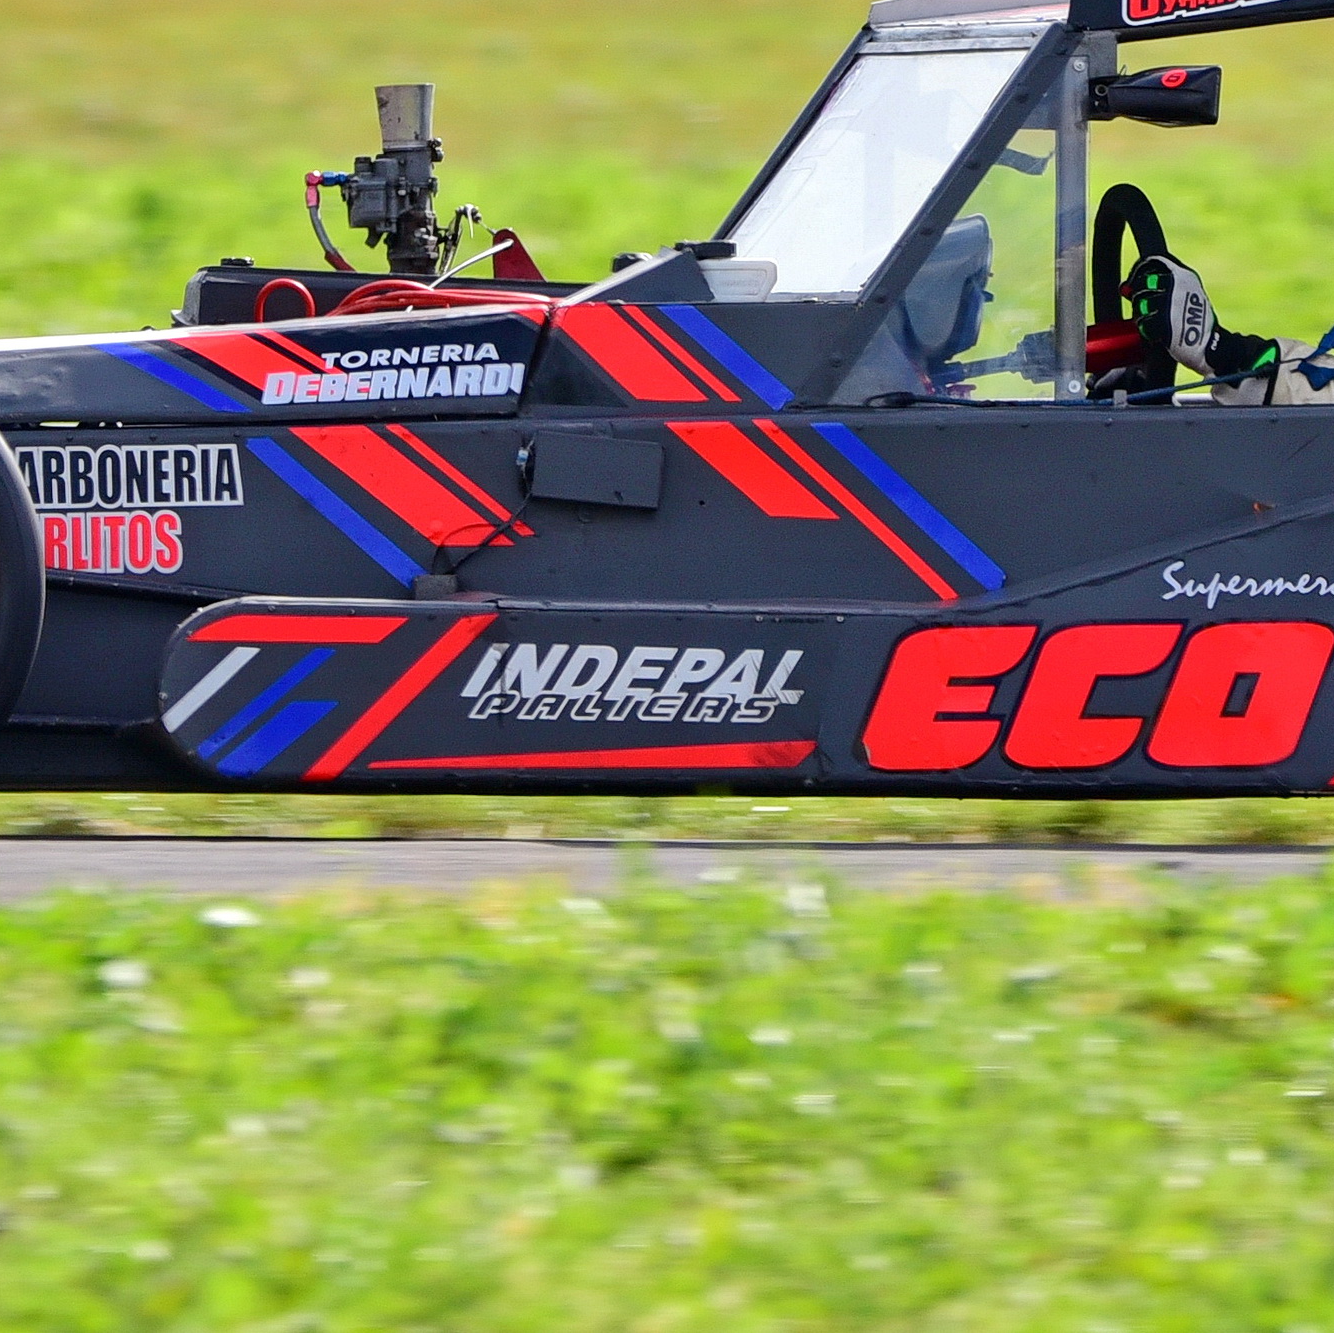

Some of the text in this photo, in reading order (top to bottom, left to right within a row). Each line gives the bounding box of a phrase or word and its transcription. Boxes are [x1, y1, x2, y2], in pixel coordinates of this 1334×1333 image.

[1184, 293, 1205, 347] OMP
[322, 342, 500, 370] TORNERIA
[261, 363, 526, 405] DEBERNARDI
[17, 445, 242, 508] ARBONERIA
[41, 512, 182, 573] RLITOS
[460, 642, 805, 705] INDEPAL
[468, 689, 785, 724] PALIERS
